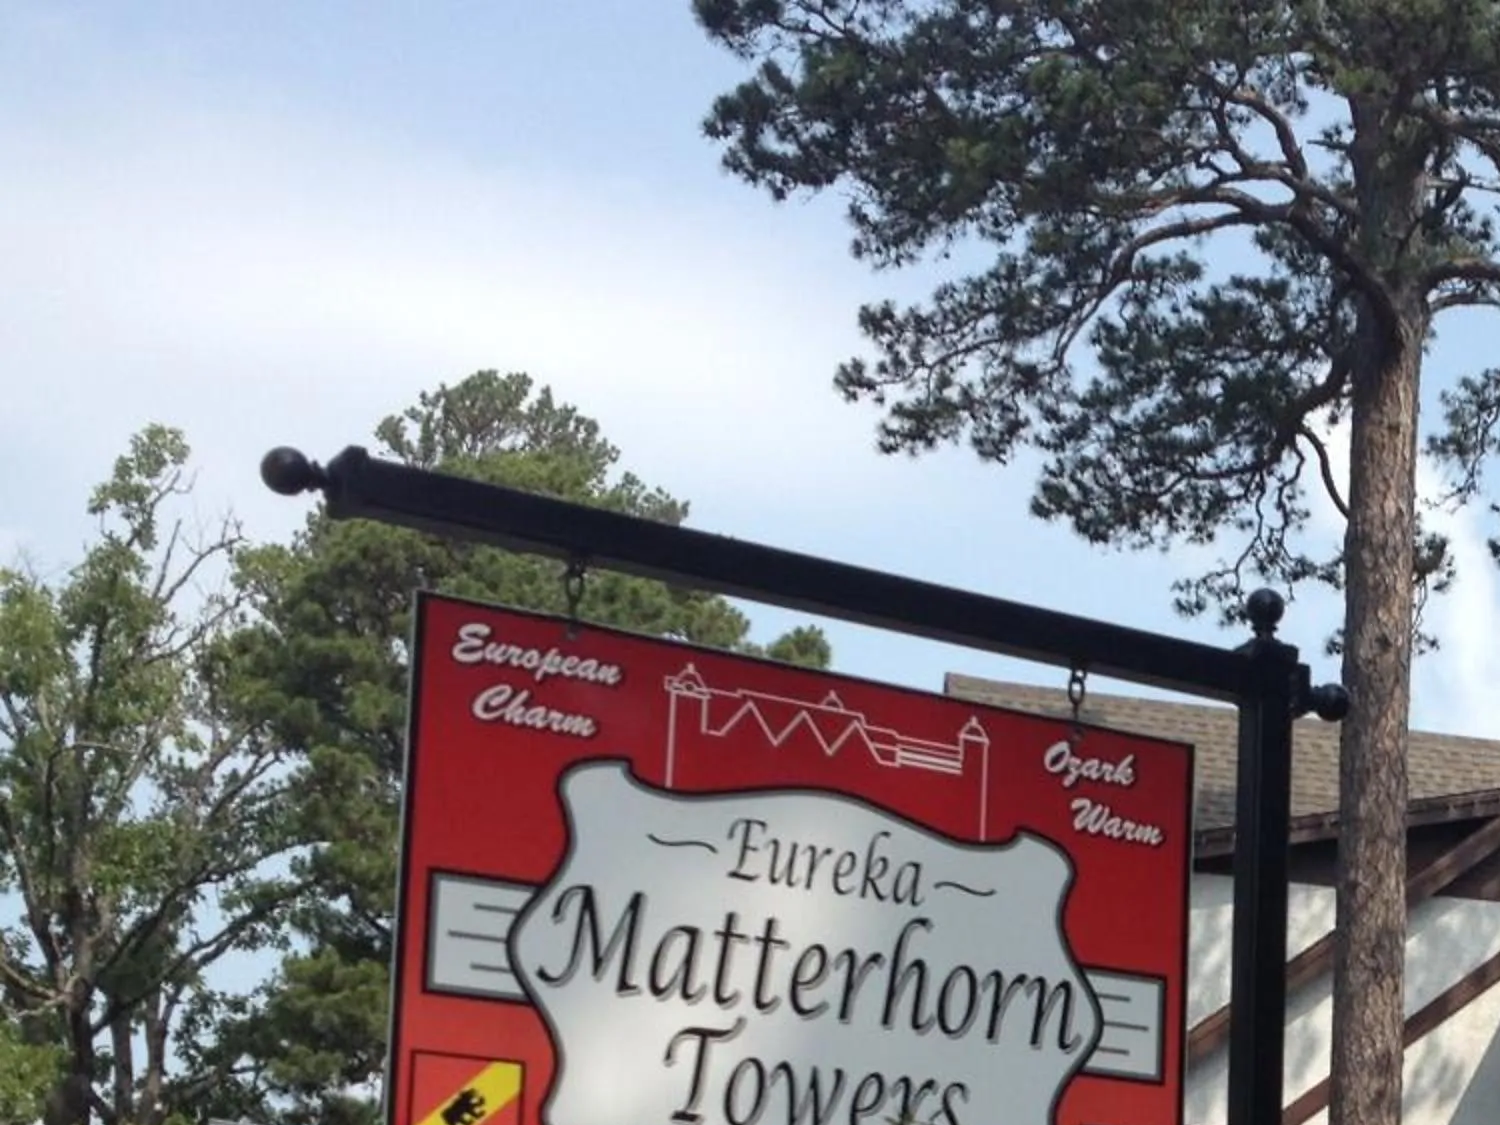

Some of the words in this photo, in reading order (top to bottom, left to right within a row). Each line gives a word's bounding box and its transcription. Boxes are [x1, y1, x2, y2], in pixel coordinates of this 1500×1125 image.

[452, 622, 622, 686] European
[472, 684, 597, 738] Charm
[1043, 740, 1135, 788] Ozark
[1070, 797, 1164, 846] Warm
[727, 817, 926, 907] Eureka
[535, 883, 1083, 1054] Matterhorn
